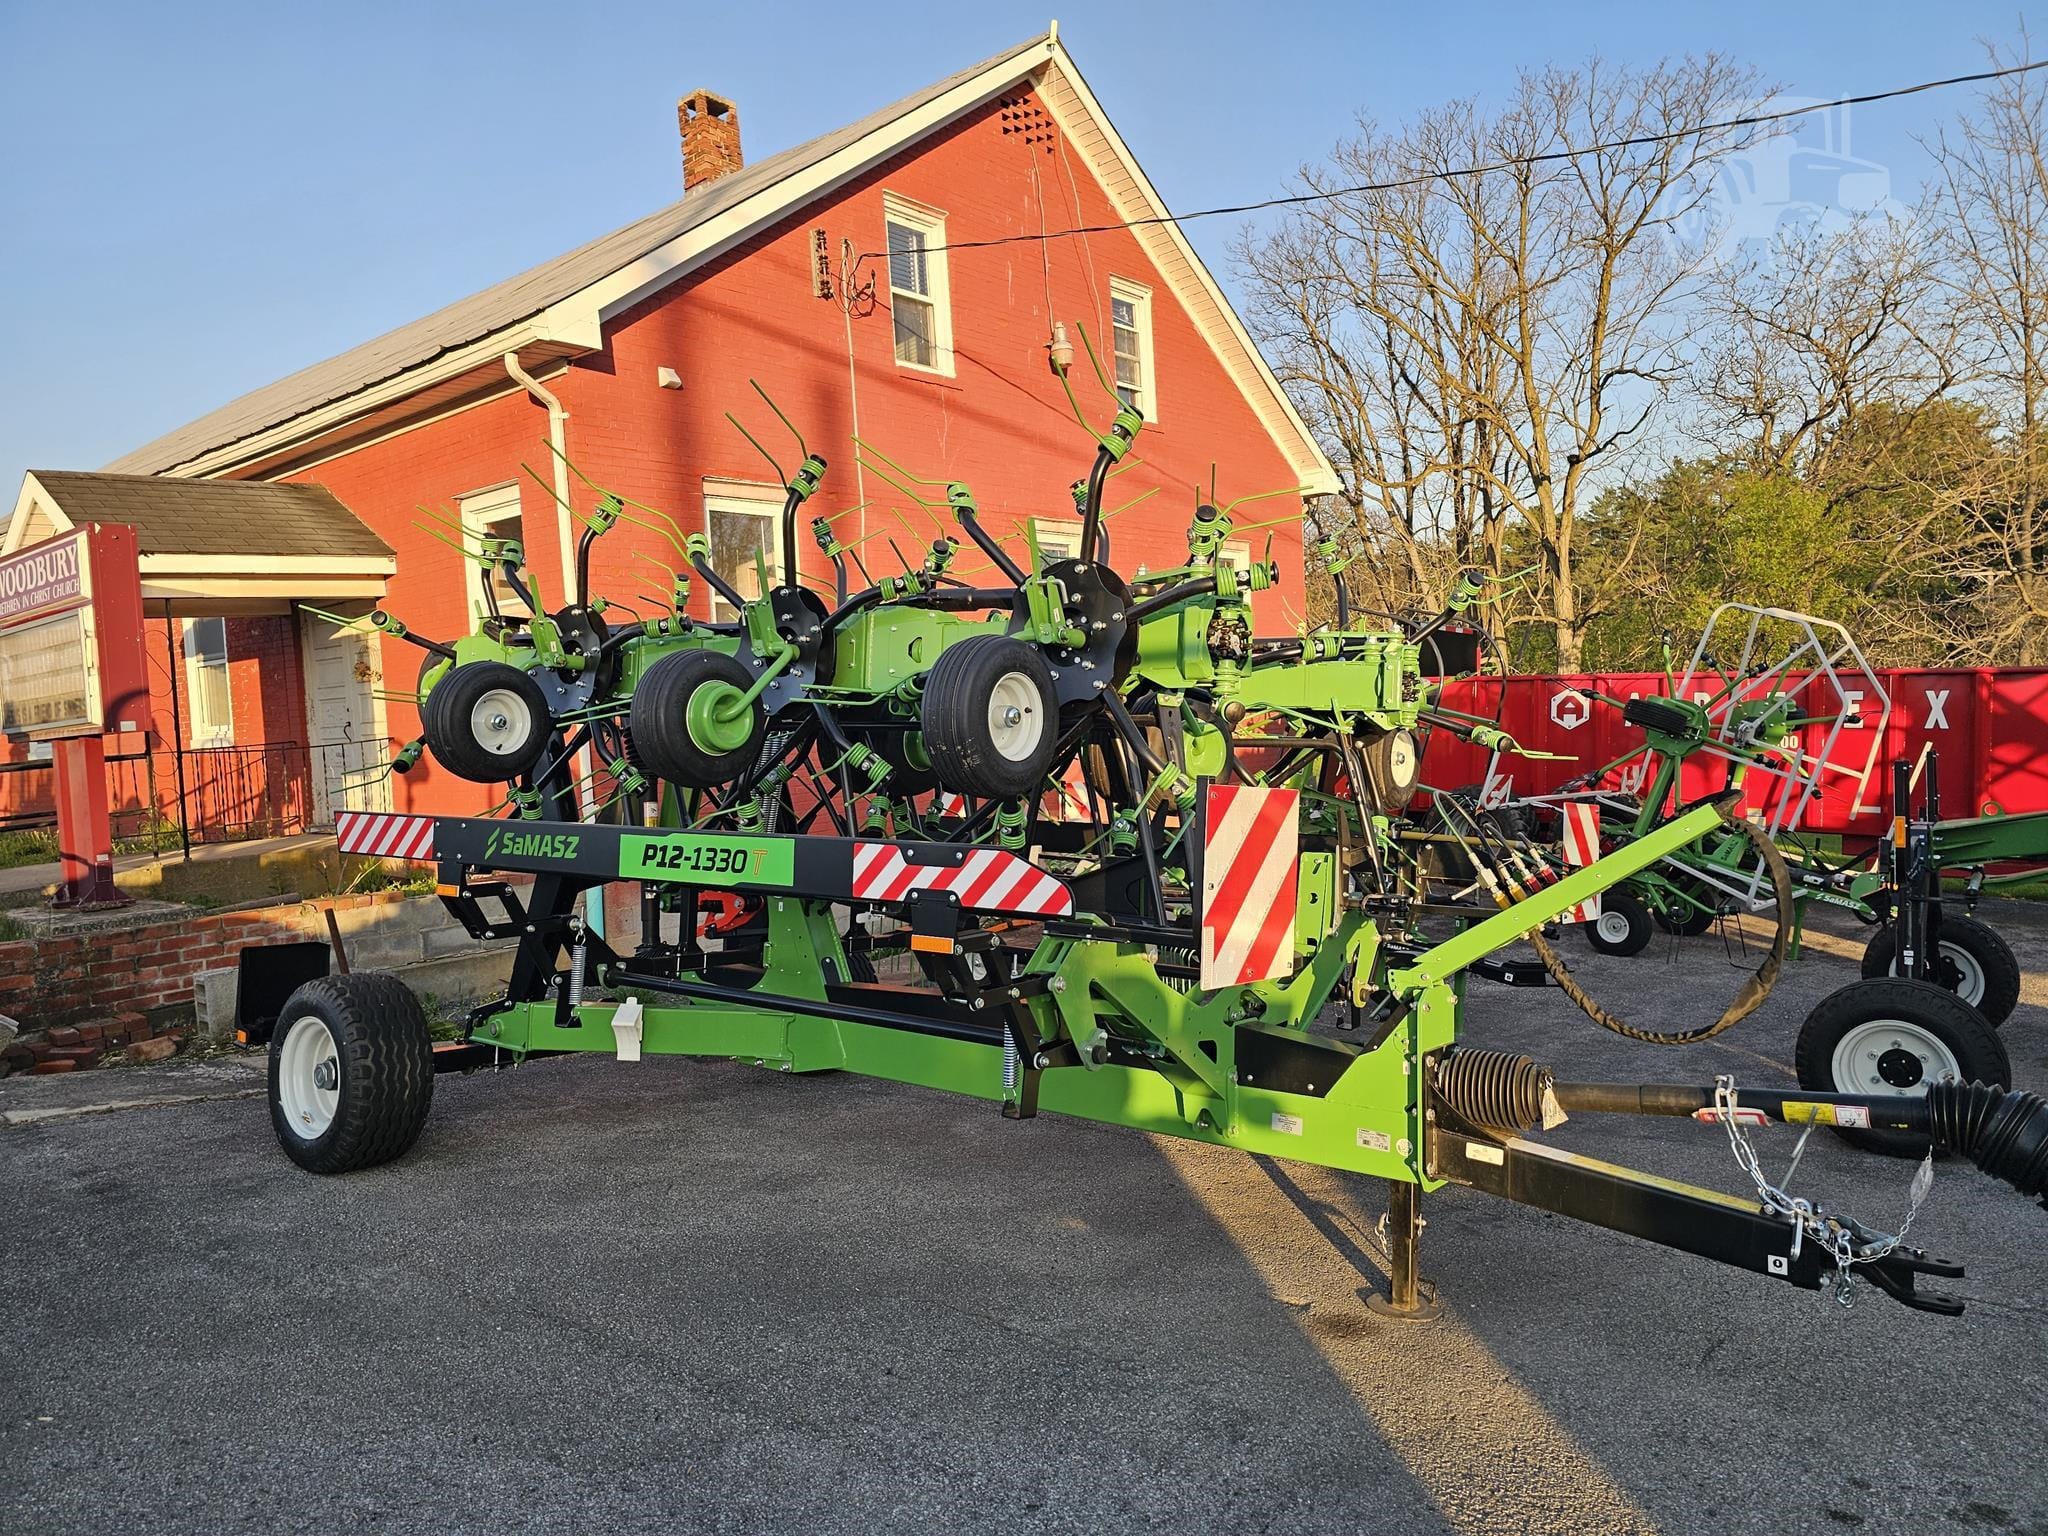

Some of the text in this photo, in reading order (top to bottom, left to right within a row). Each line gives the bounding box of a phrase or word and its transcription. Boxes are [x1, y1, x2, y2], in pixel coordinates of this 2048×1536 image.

[0, 578, 80, 615] ETHREN IN CHRIST CHURCH
[500, 832, 580, 859] SaMASZ
[641, 843, 768, 876] P12-1330 T
[1823, 894, 1861, 911] SaMASZ
